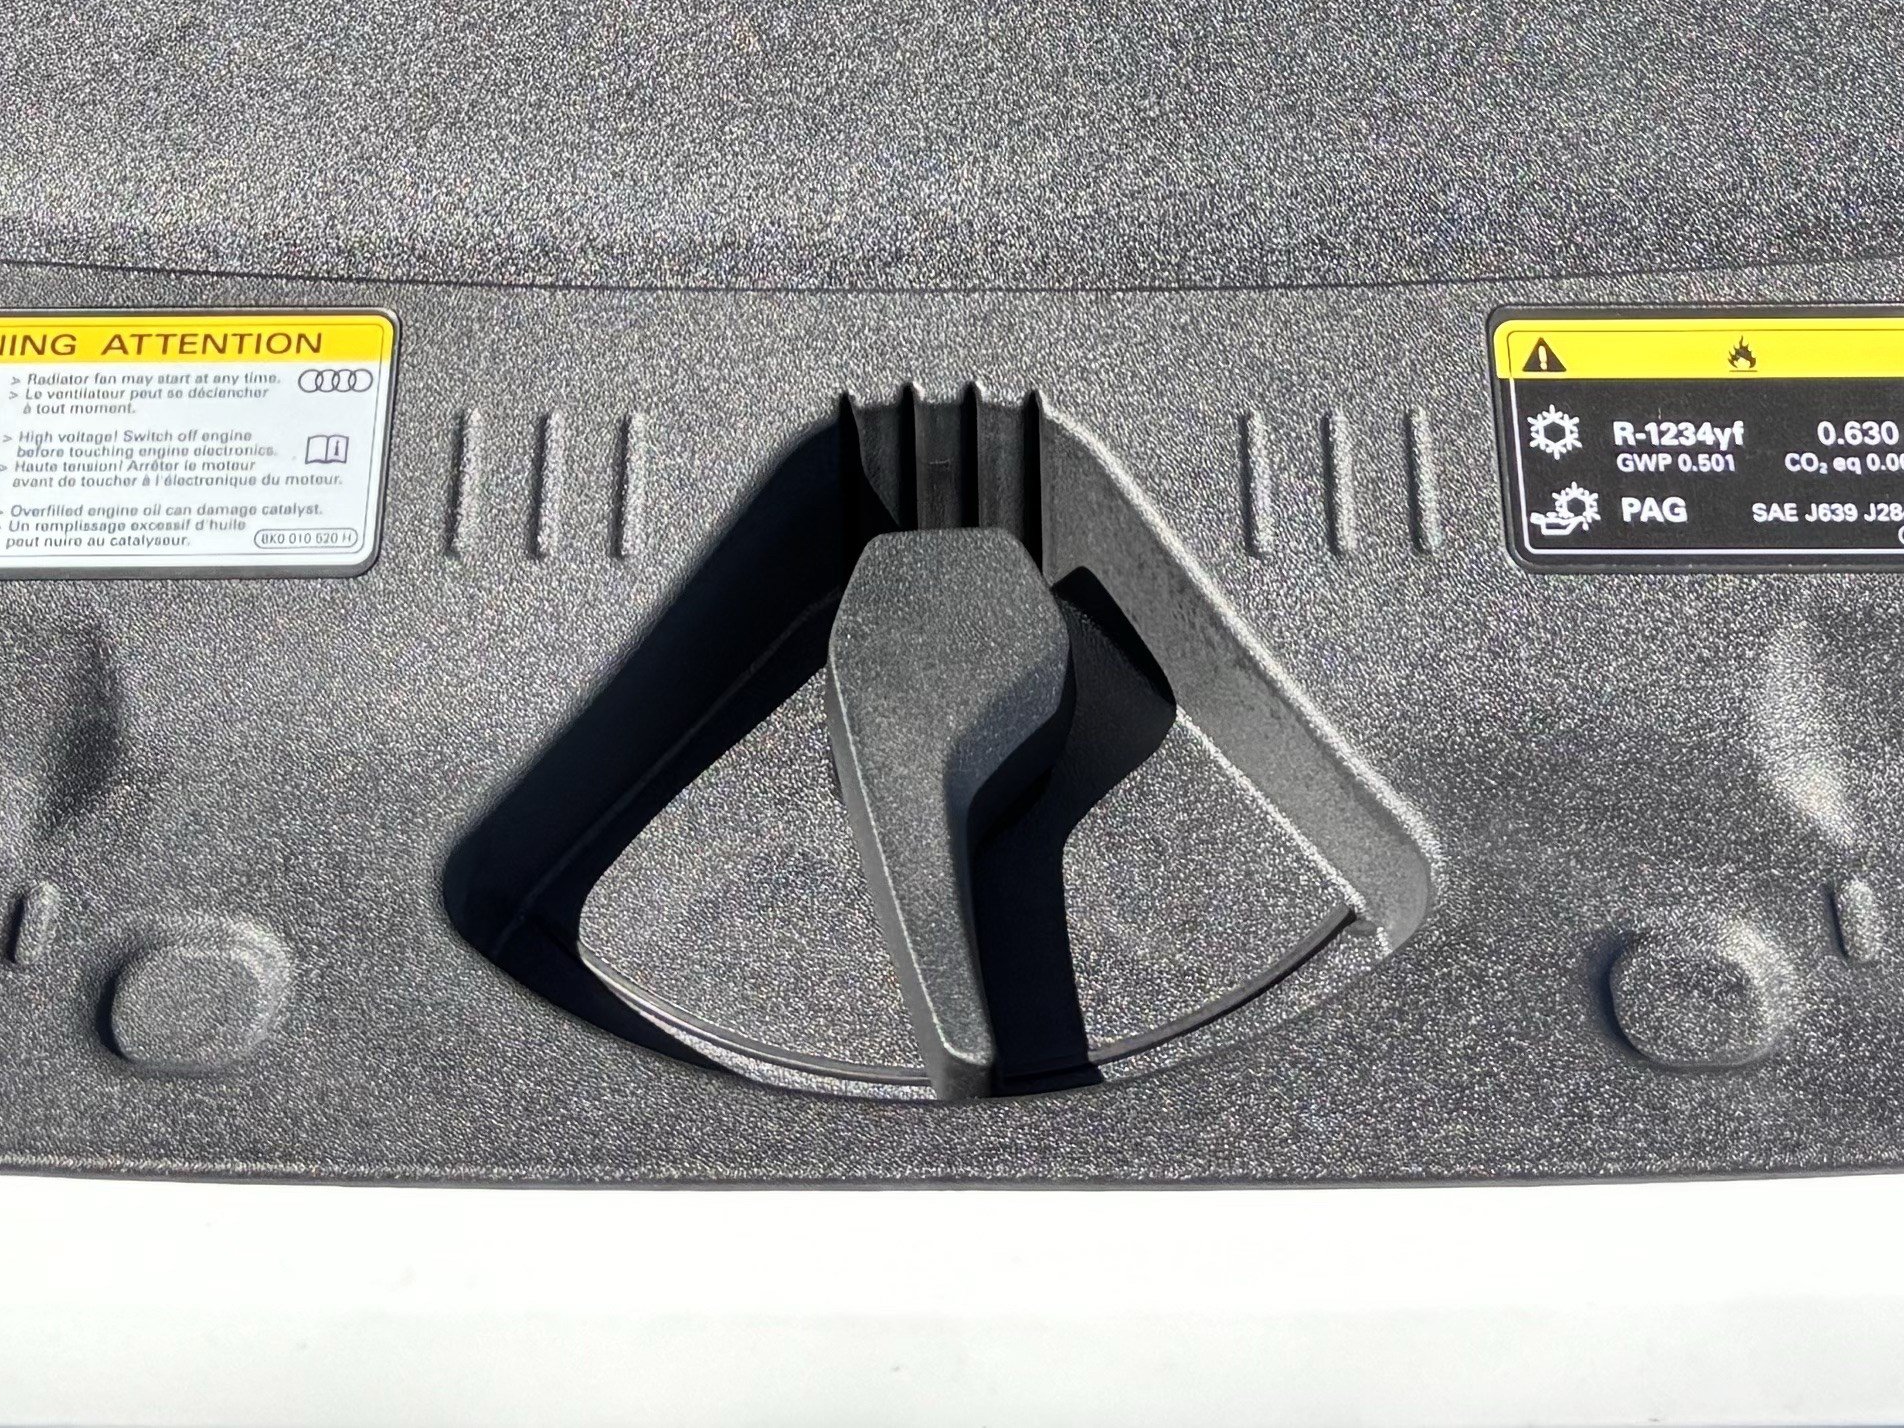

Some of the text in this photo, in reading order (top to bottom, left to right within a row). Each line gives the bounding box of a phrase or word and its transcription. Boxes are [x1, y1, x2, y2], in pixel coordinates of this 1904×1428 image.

[100, 332, 322, 356] ATTENTION
[27, 373, 89, 386] Radiator
[94, 373, 116, 385] fan
[121, 375, 152, 387] may
[157, 374, 190, 385] start
[195, 374, 210, 384] at
[213, 375, 239, 386] any
[26, 388, 42, 400] Le
[47, 388, 125, 400] ventilateur
[130, 388, 162, 401] peut
[167, 389, 183, 399] se
[37, 404, 65, 414] tout
[19, 430, 53, 446] High
[123, 429, 172, 443] Switch
[178, 429, 199, 442] off
[202, 430, 252, 443] engine
[1613, 420, 1744, 450] R-1234yf
[1817, 421, 1899, 446] 0.630
[17, 446, 64, 458] before
[69, 445, 133, 459] touching
[139, 445, 189, 459] engine
[15, 460, 58, 472] Haute
[127, 459, 179, 472] Arrêter
[184, 460, 199, 471] le
[202, 461, 255, 471] moteur
[1616, 454, 1672, 472] GWP
[1678, 453, 1735, 472] 0.501
[1833, 455, 1862, 475] eq
[12, 477, 53, 488] avant
[58, 476, 76, 487] de
[81, 475, 137, 487] toucher
[261, 473, 280, 485] du
[11, 505, 83, 517] Overfilled
[88, 506, 138, 518] engine
[144, 504, 161, 516] oil
[165, 506, 191, 516] can
[197, 504, 256, 517] damage
[1622, 496, 1687, 522] PAG
[1752, 503, 1798, 522] SAE
[1805, 503, 1858, 522] J639
[9, 520, 30, 532] Un
[35, 520, 126, 534] remplissage
[131, 519, 190, 531] excessif
[6, 536, 39, 550] peut
[45, 535, 82, 547] nuire
[87, 537, 105, 547] au
[289, 533, 311, 543] 010
